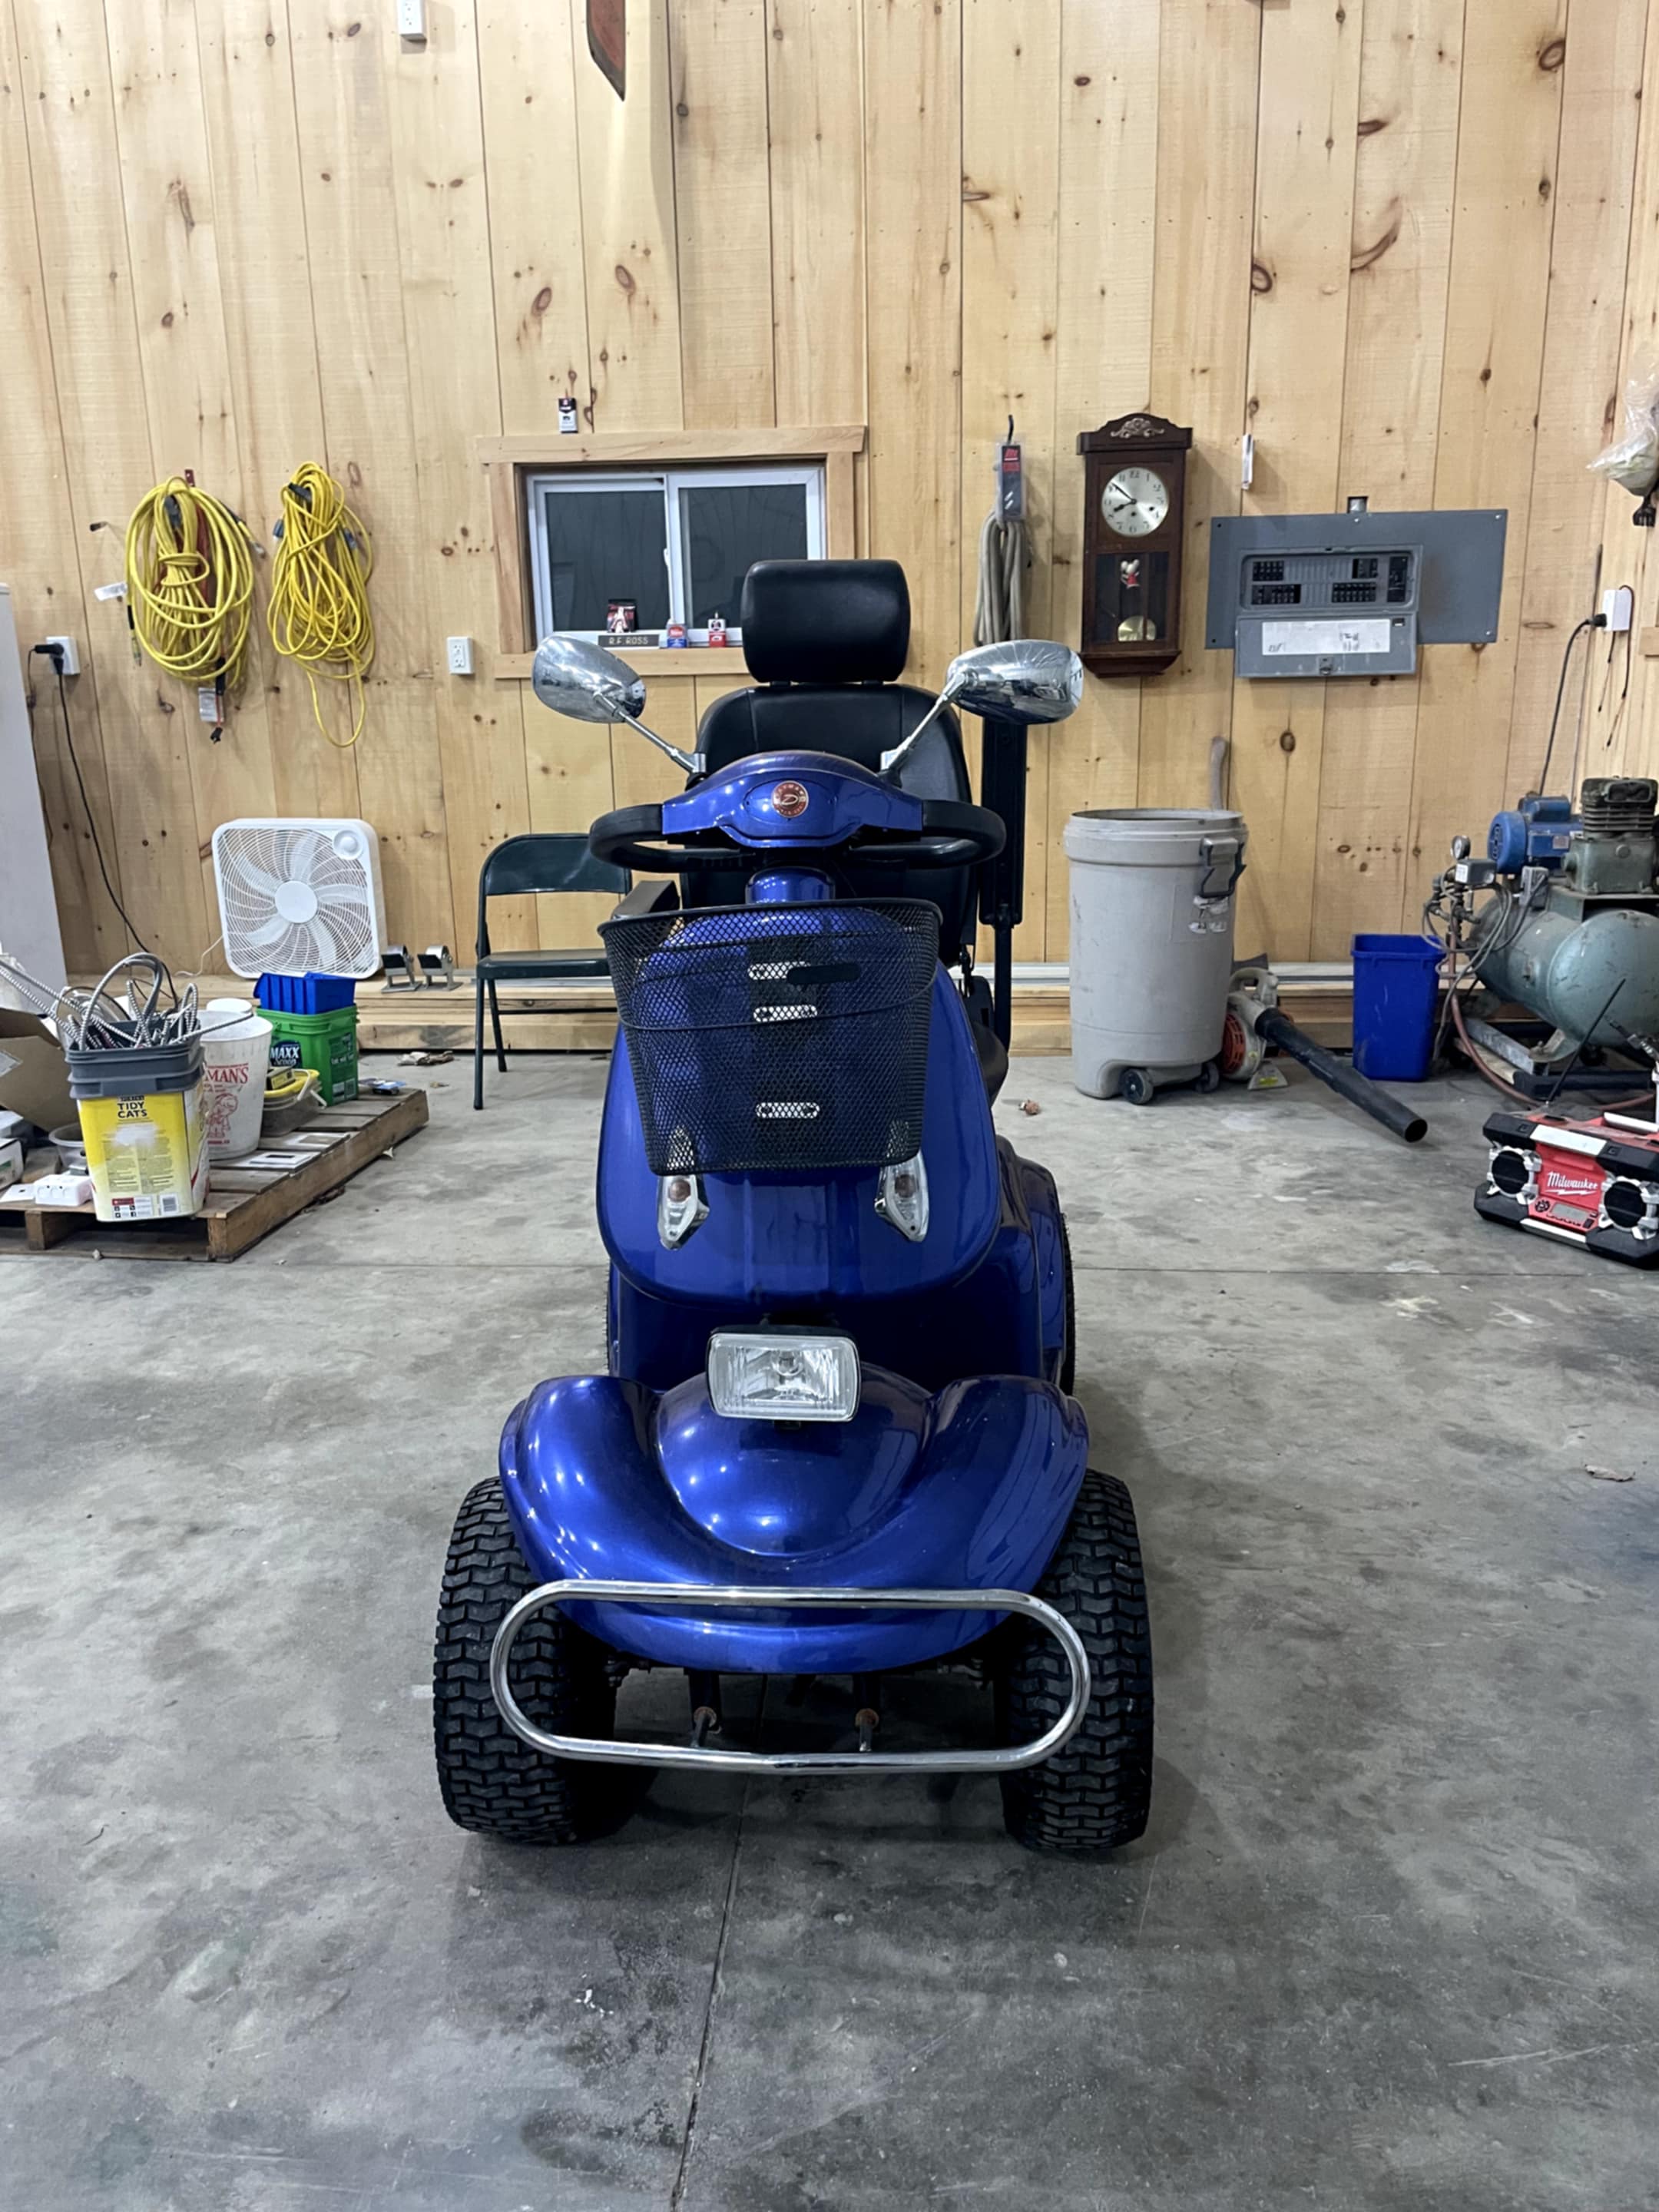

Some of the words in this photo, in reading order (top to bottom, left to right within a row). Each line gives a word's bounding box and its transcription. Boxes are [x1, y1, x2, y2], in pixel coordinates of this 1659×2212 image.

[625, 636, 648, 644] ROSS
[270, 1046, 300, 1058] MAXX
[117, 1101, 144, 1110] TIDY
[118, 1109, 147, 1118] CATS
[1547, 1171, 1598, 1189] Milwaukee
